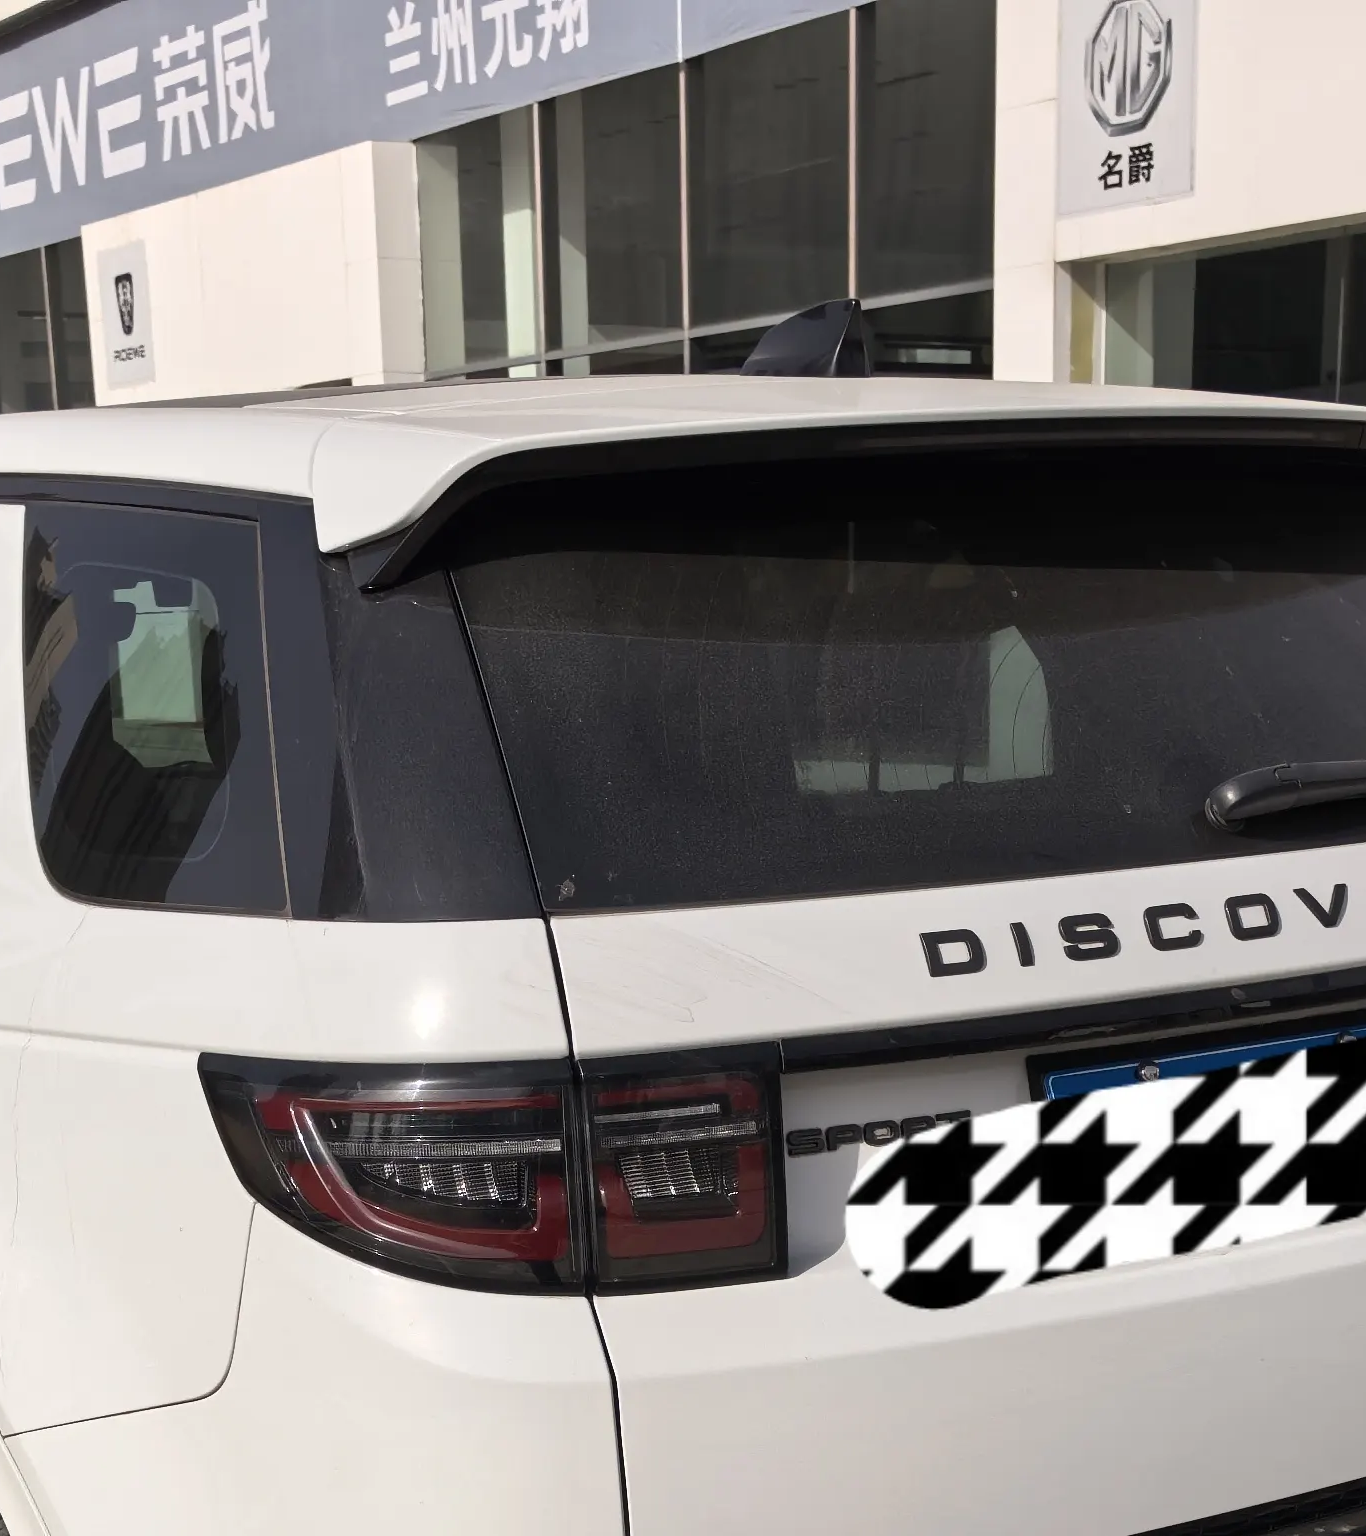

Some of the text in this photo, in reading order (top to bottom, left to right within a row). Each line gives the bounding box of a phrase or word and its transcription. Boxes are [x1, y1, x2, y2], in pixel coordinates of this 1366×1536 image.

[152, 0, 276, 163] 荣威
[1097, 142, 1155, 191] 名爵
[113, 344, 147, 364] ROEWE
